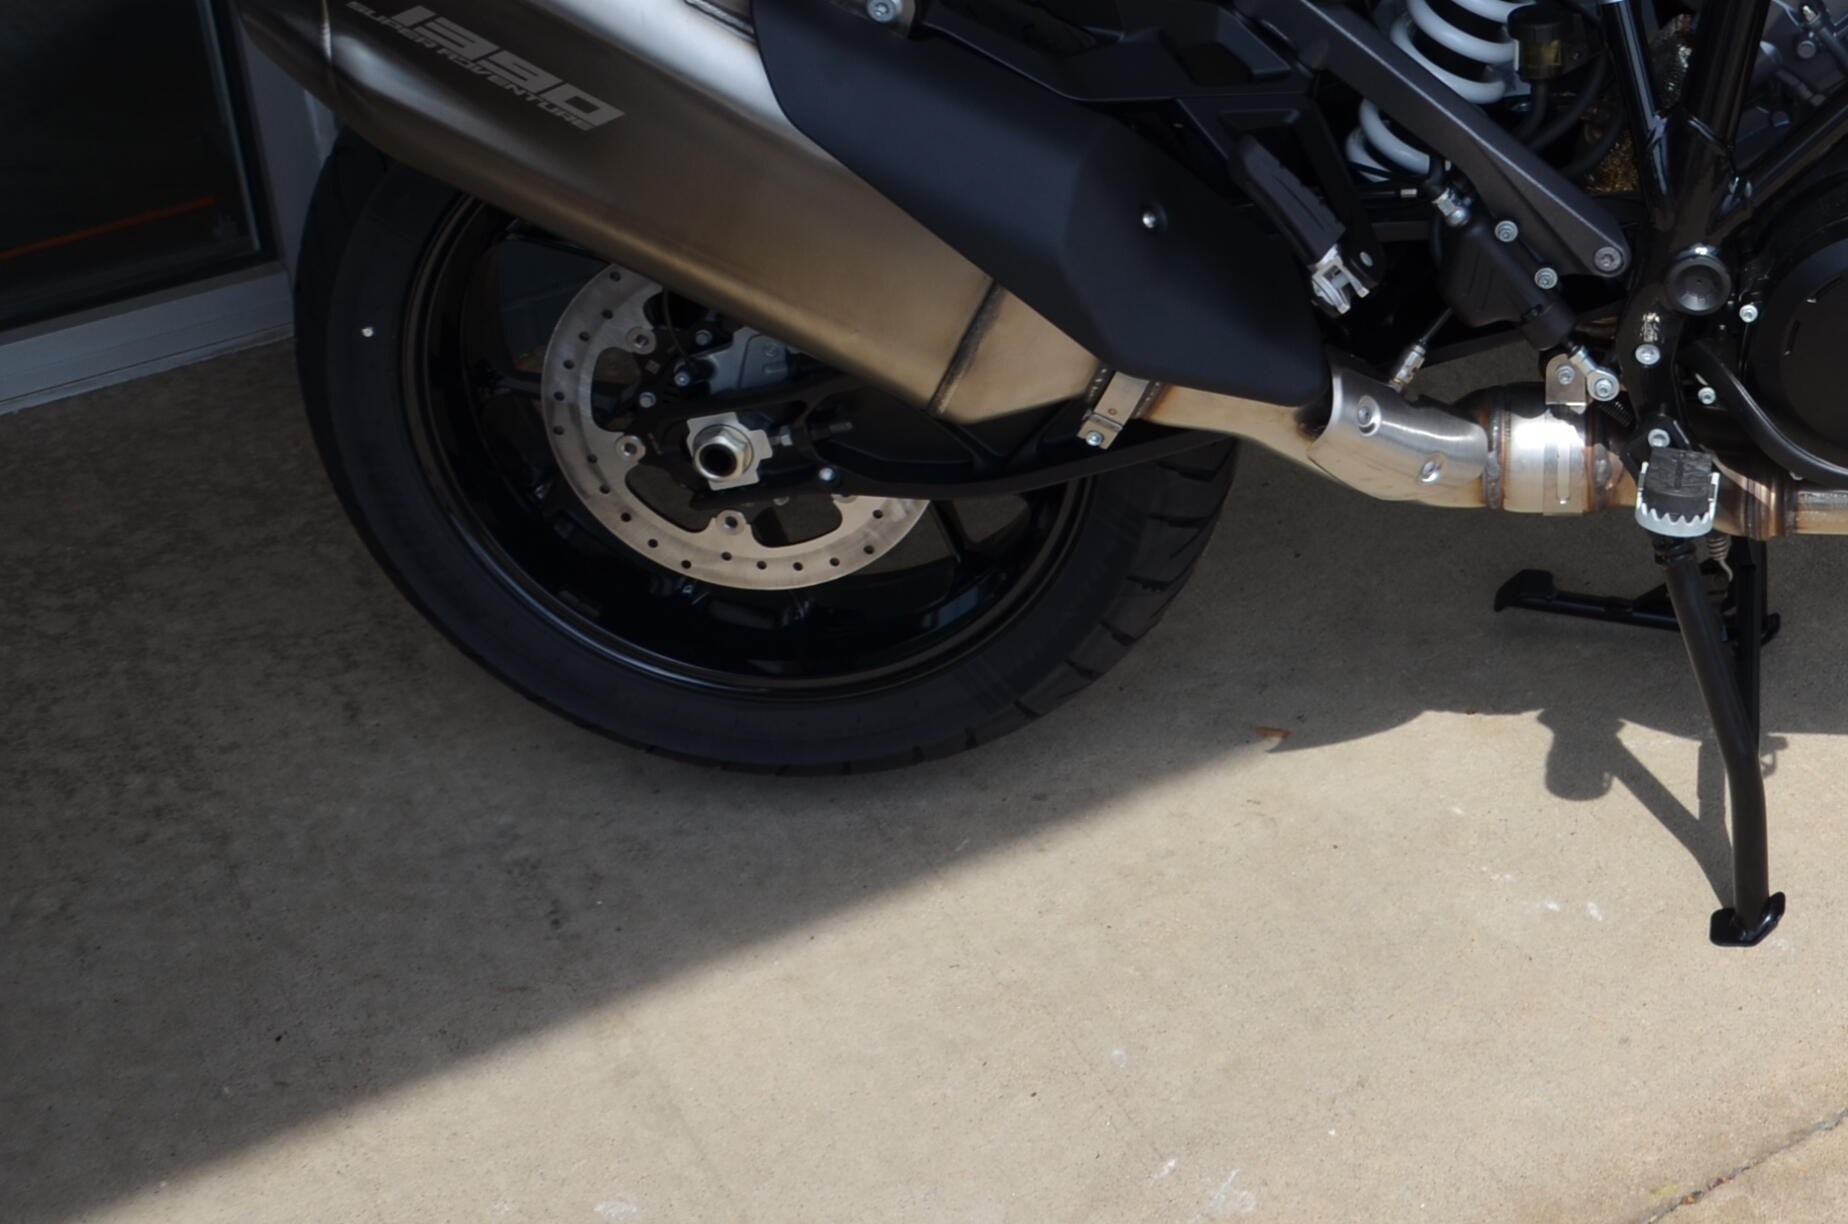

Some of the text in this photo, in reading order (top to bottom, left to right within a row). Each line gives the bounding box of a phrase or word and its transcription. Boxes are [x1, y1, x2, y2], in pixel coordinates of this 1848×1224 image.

[346, 1, 596, 132] SUPER ADVENTURE
[391, 5, 626, 128] 1390
